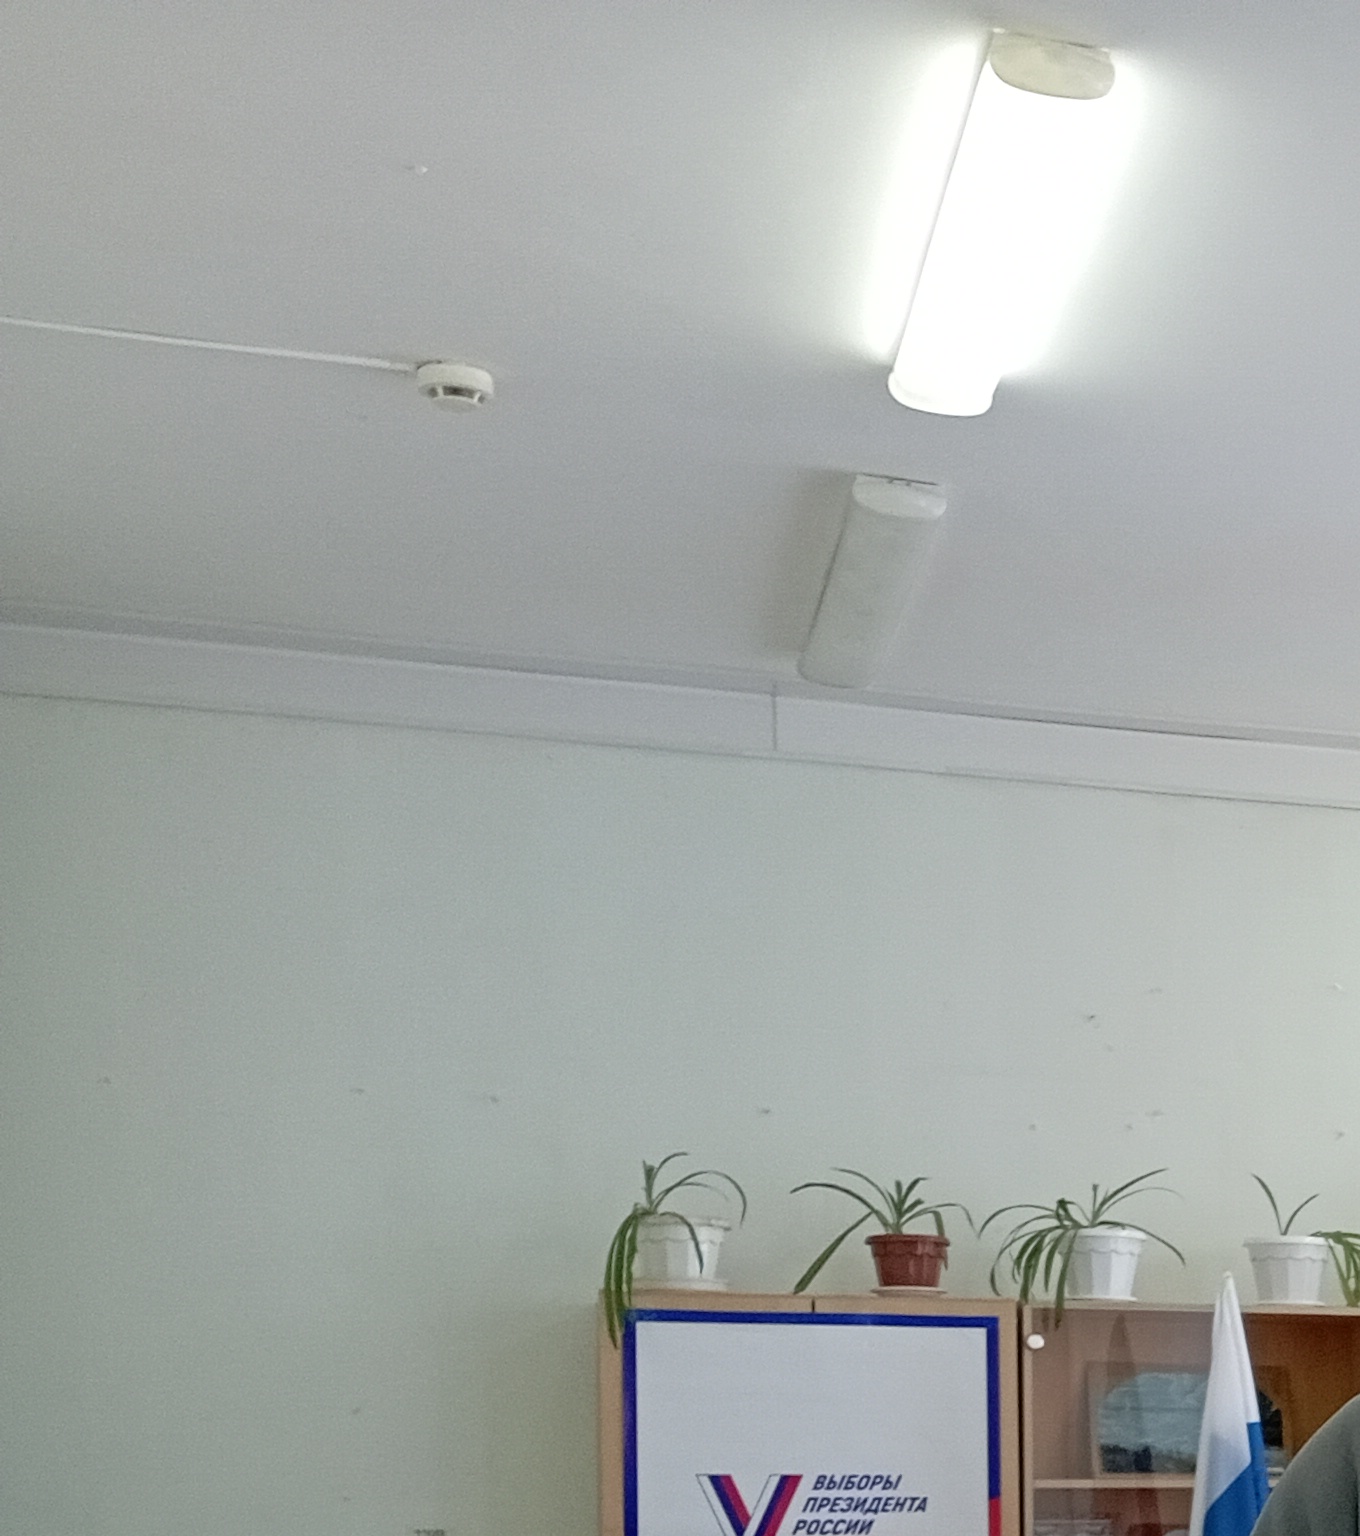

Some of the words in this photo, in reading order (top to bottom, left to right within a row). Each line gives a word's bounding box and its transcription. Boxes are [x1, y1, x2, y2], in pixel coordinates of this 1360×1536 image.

[812, 1474, 902, 1491] ВЫБОРЫ
[802, 1496, 929, 1515] ПРЕЗИДЕНТА
[792, 1519, 875, 1536] РОССИИ
